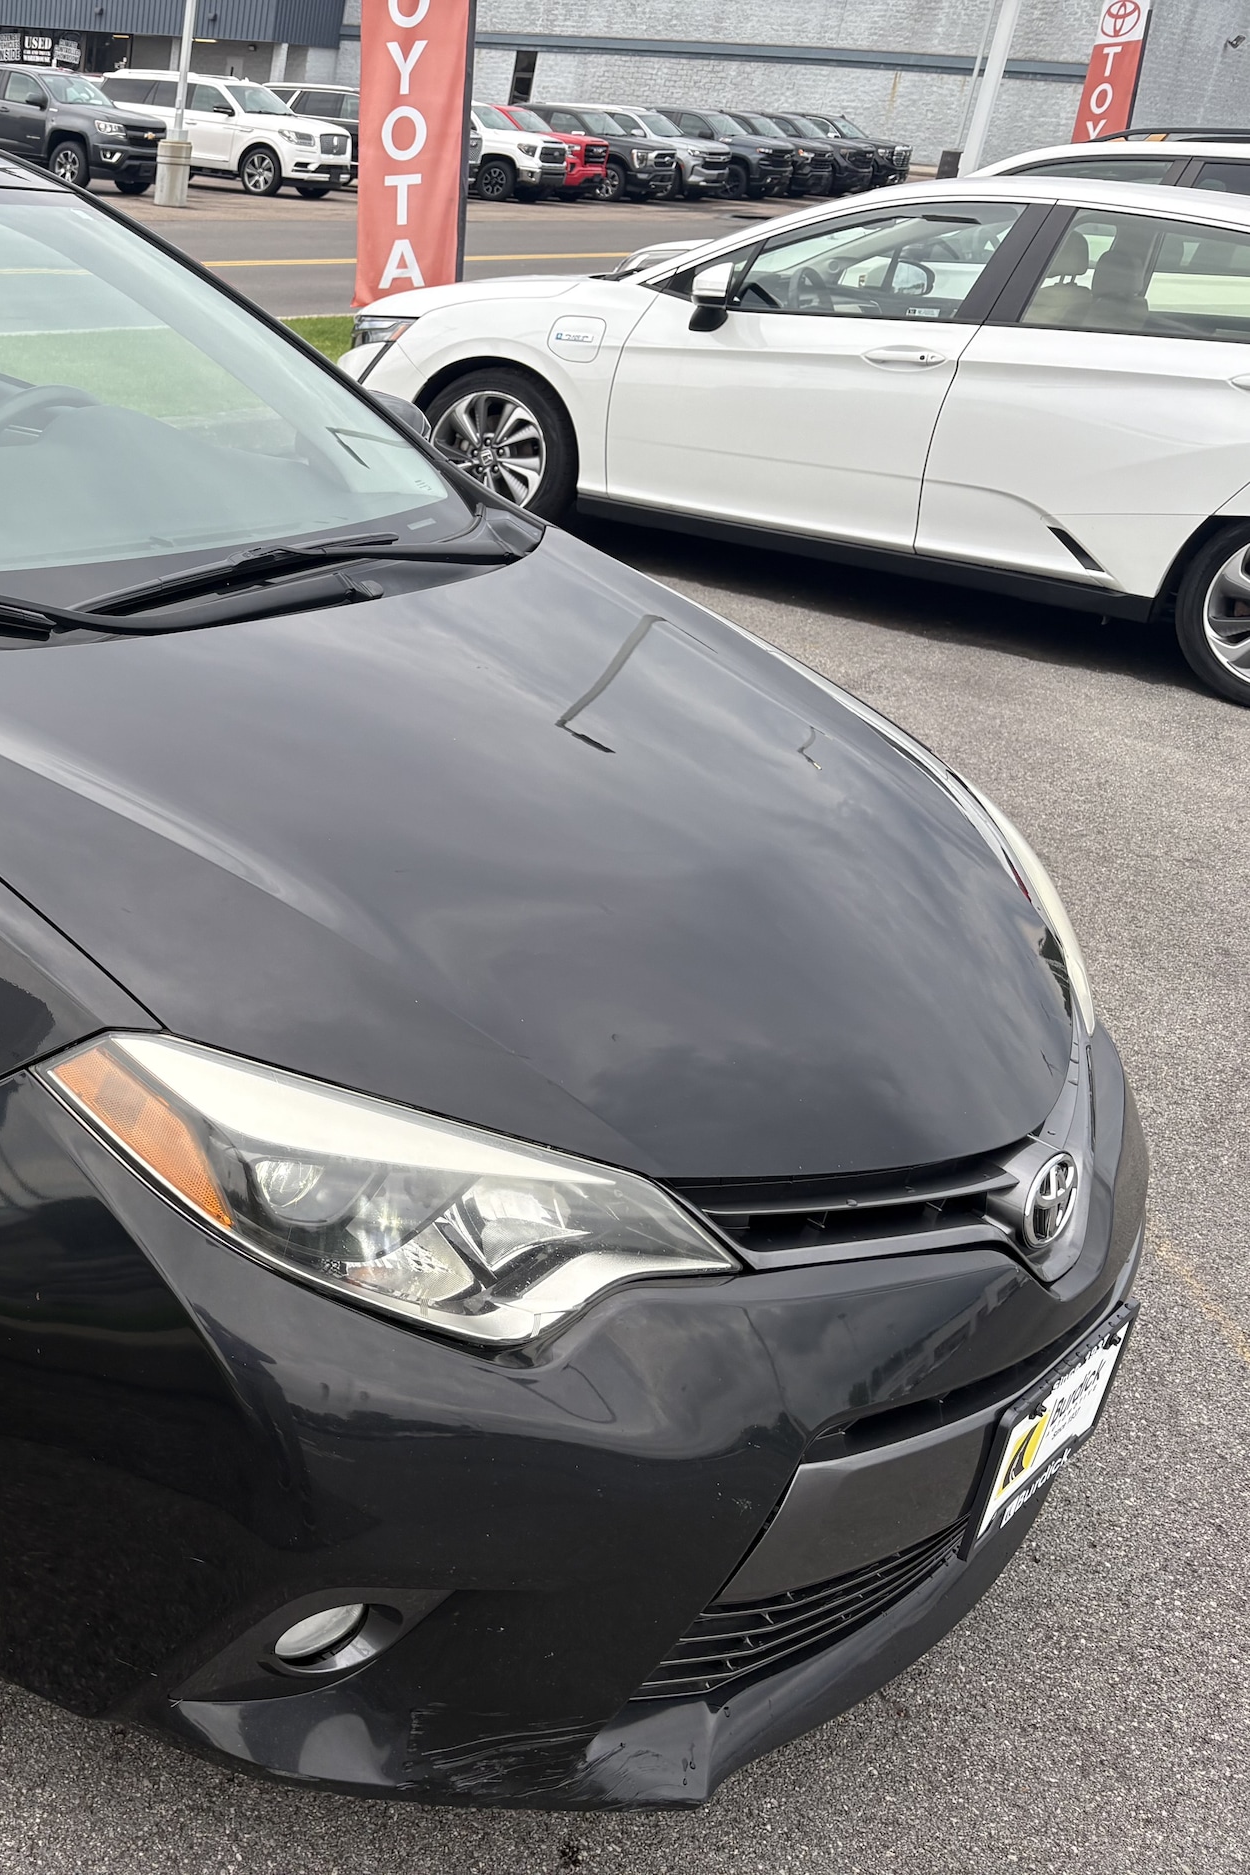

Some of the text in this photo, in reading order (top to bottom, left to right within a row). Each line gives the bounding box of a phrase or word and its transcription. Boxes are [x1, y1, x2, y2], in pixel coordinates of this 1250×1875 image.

[24, 36, 52, 50] USED
[1050, 1359, 1106, 1427] Burdick
[1014, 1448, 1072, 1513] Burdick
